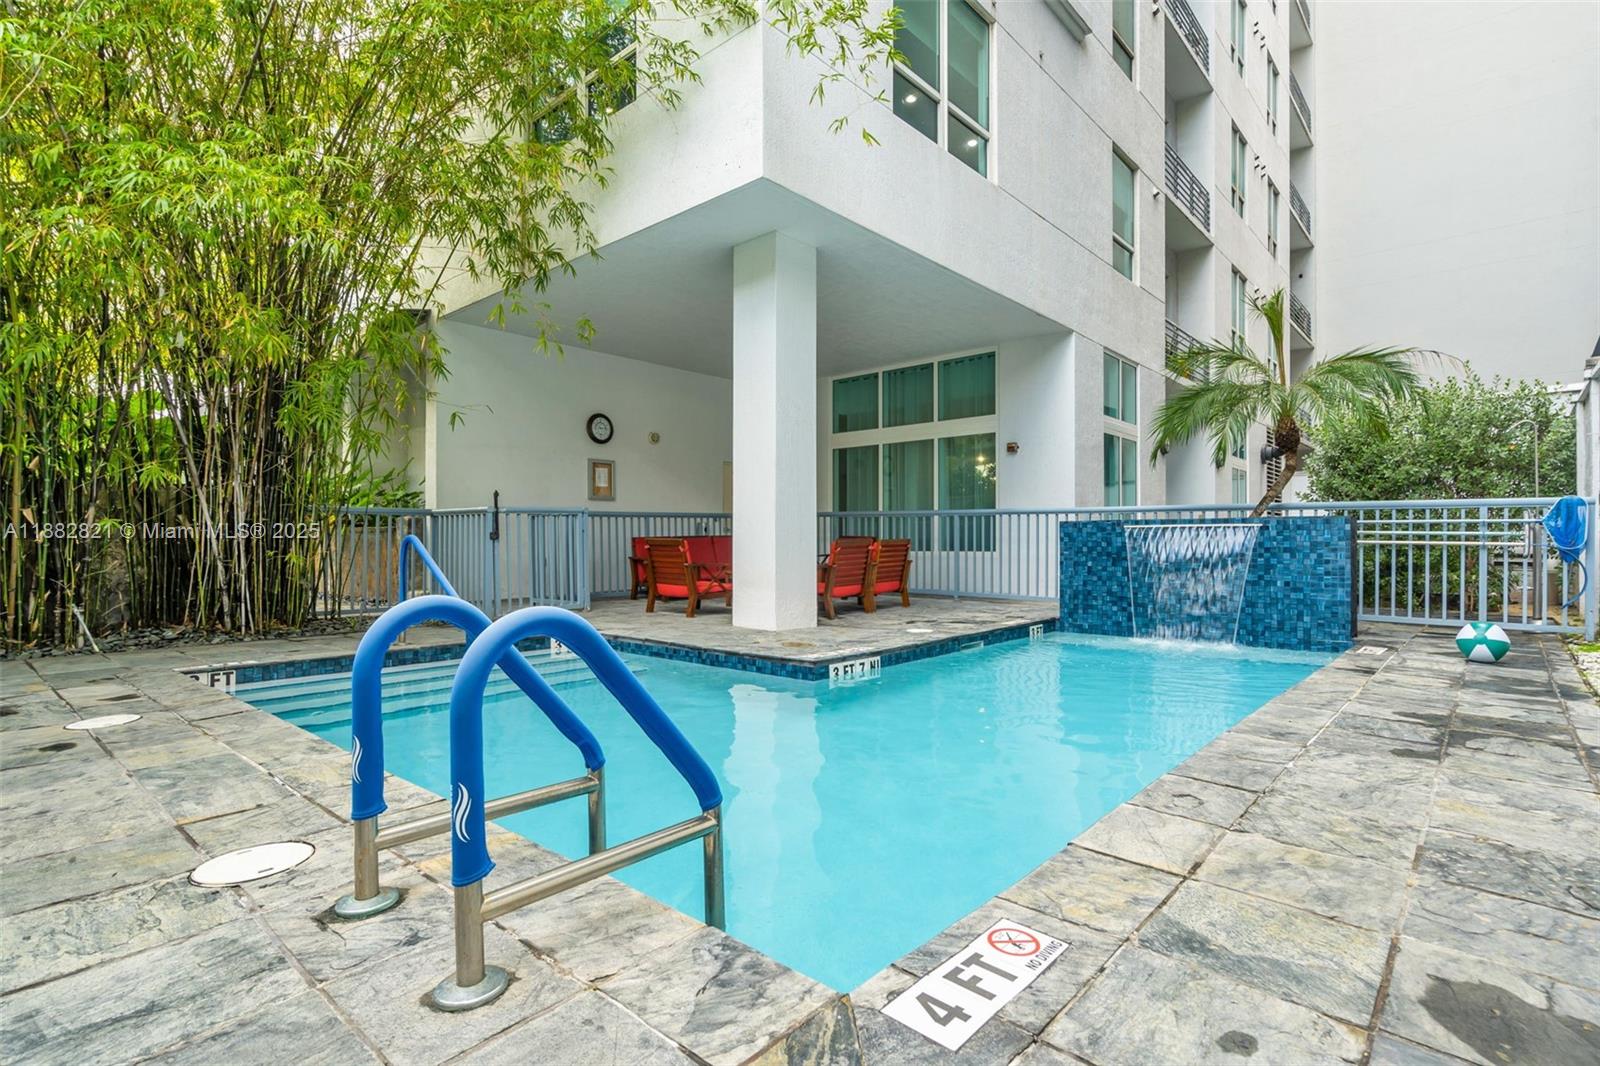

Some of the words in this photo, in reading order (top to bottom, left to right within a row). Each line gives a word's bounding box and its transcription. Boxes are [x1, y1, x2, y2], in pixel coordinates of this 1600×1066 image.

[210, 671, 234, 687] FT
[843, 663, 855, 675] FT
[859, 662, 865, 672] 7
[1025, 959, 1042, 971] NO
[1035, 940, 1062, 961] DIVING
[942, 952, 1019, 1001] FT
[915, 992, 972, 1027] 4
